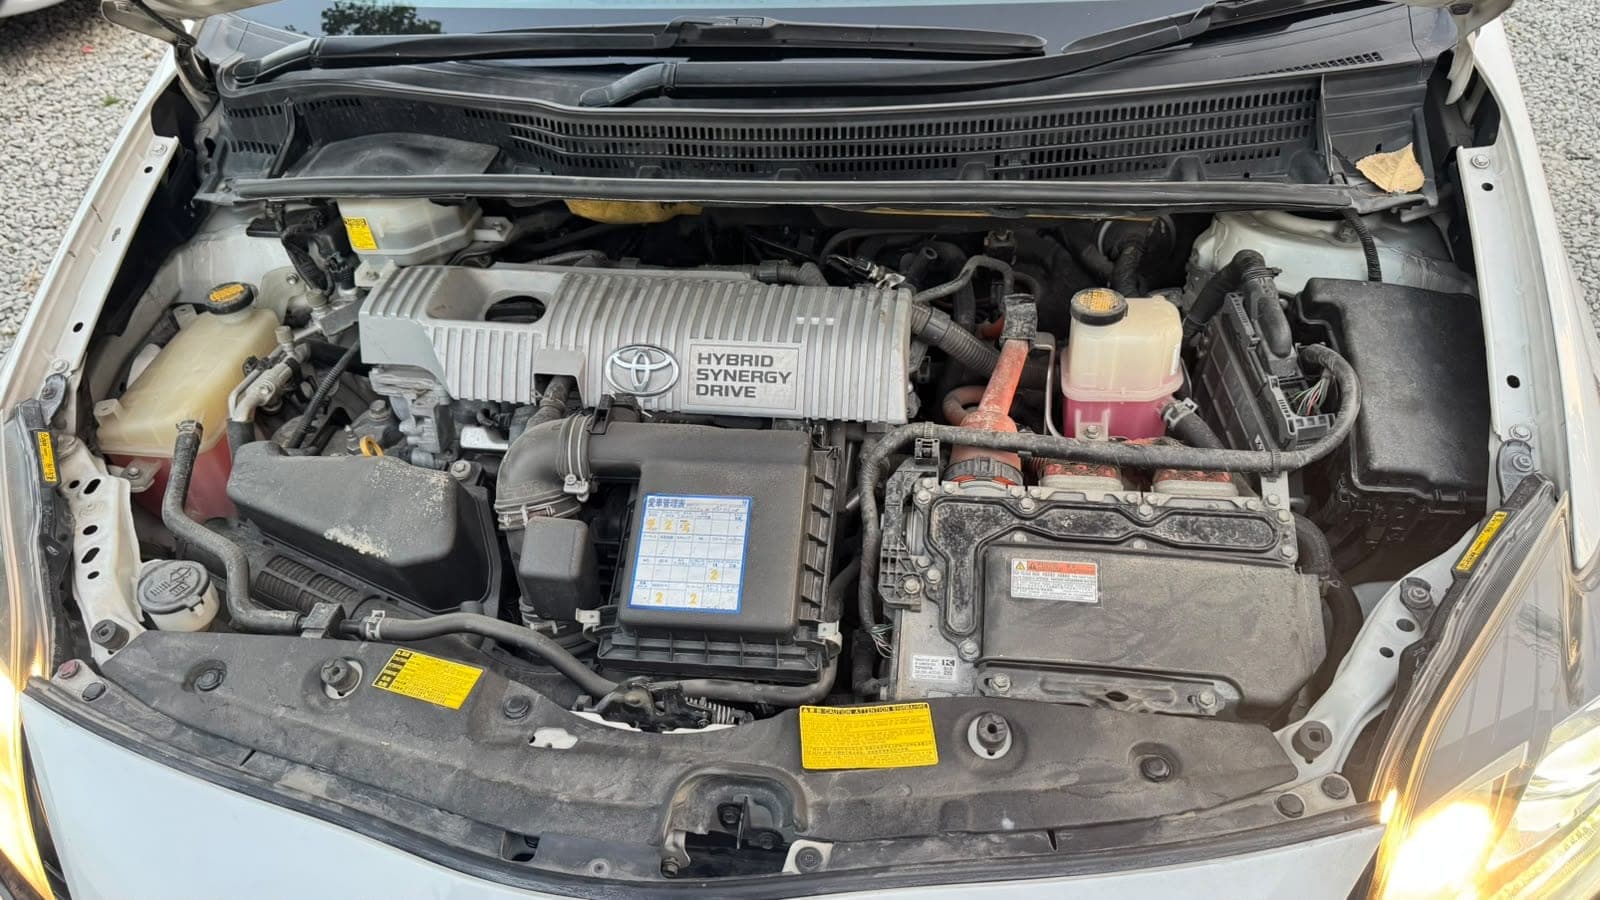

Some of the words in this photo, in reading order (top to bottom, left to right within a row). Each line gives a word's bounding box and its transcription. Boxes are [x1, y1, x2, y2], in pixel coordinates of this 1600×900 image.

[698, 353, 774, 367] HYBRID
[696, 368, 792, 384] SYNERGY
[695, 384, 757, 398] DRIVE
